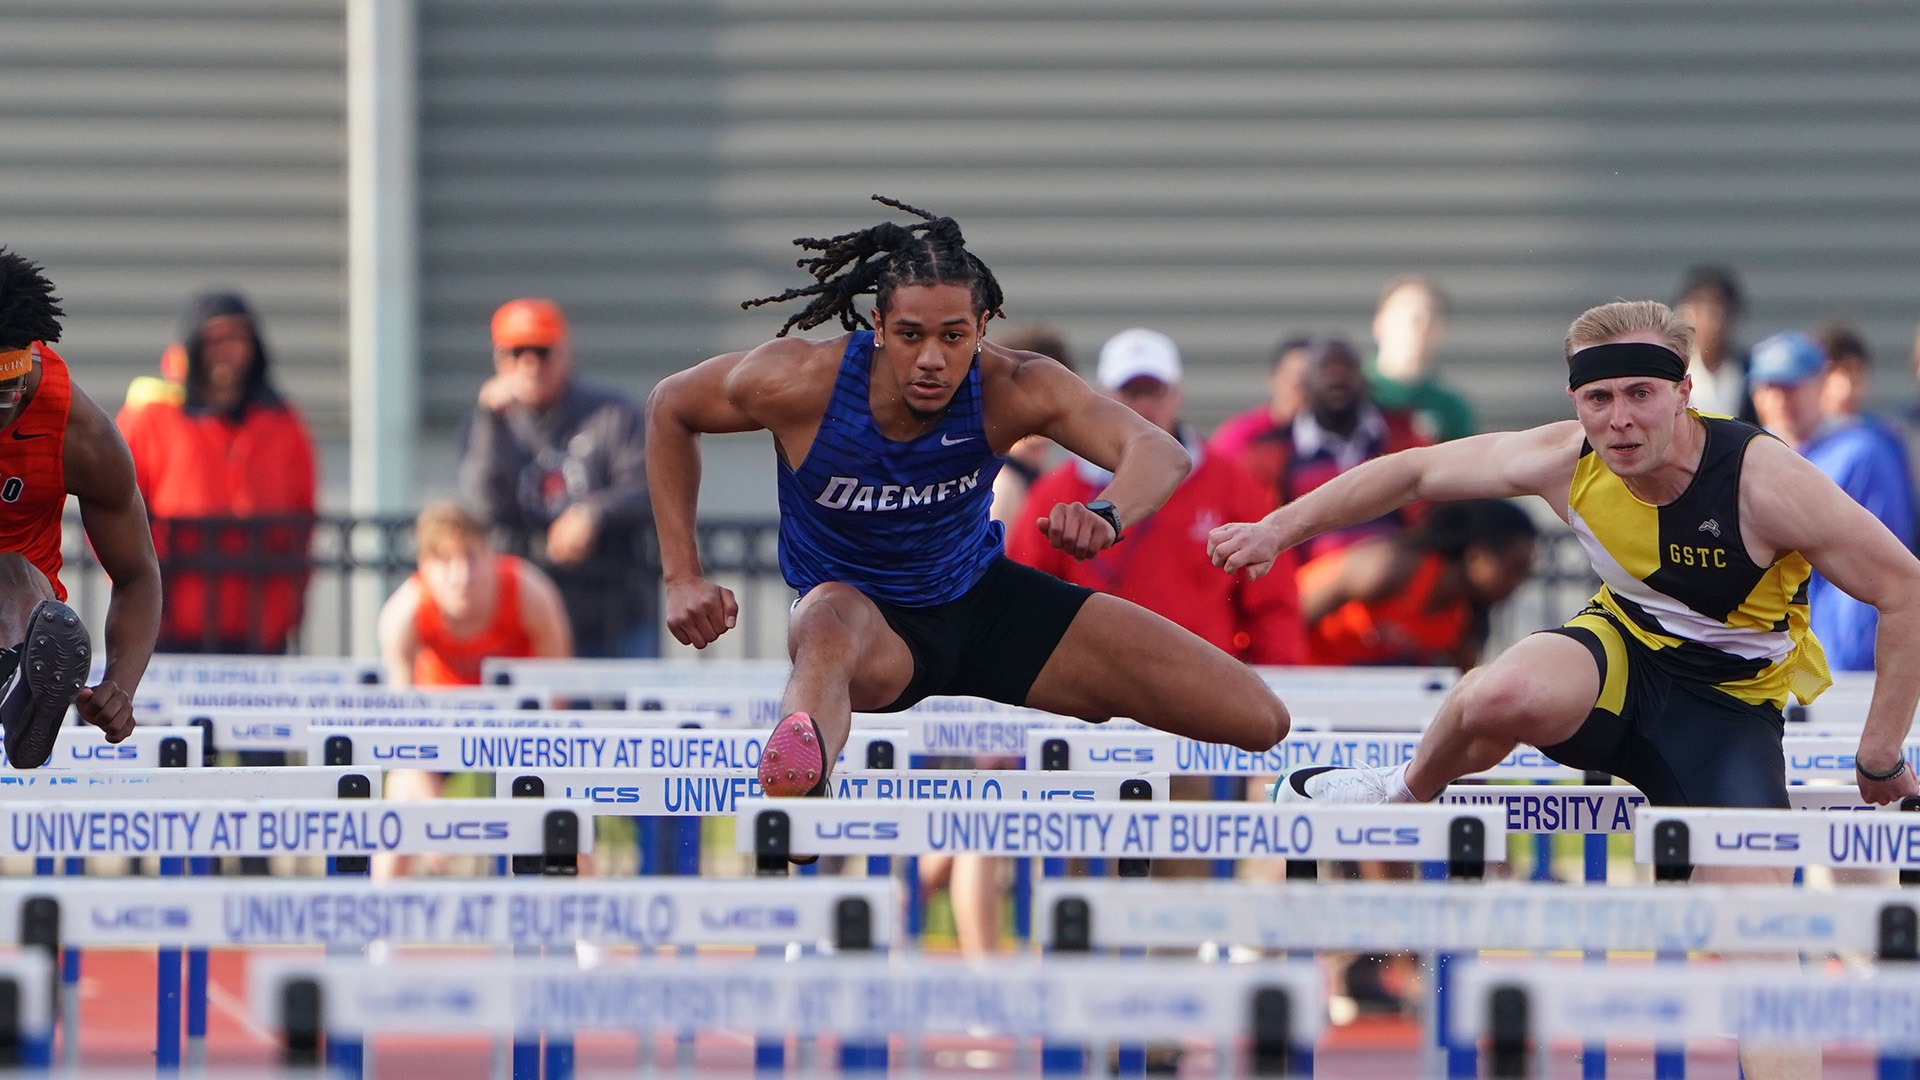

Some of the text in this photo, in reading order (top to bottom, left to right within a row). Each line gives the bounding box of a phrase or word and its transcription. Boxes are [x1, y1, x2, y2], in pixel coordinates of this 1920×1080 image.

[815, 468, 980, 512] DAEMEN
[1669, 543, 1727, 568] GSTC
[71, 745, 138, 760] UCS
[373, 737, 761, 769] UCS UNIVERSITY AT BUFFALO
[1089, 747, 1154, 762] UCS
[1791, 755, 1857, 770] UCS
[565, 786, 641, 803] UCS
[11, 811, 510, 851] UNIVERSITY AT BUFFALO UCS
[815, 812, 1420, 854] UCS UNIVERSITY AT BUFFALO UCS
[1716, 831, 1800, 852] UCS
[222, 894, 440, 942] UNIVERSITY
[508, 894, 675, 941] BUFFALO
